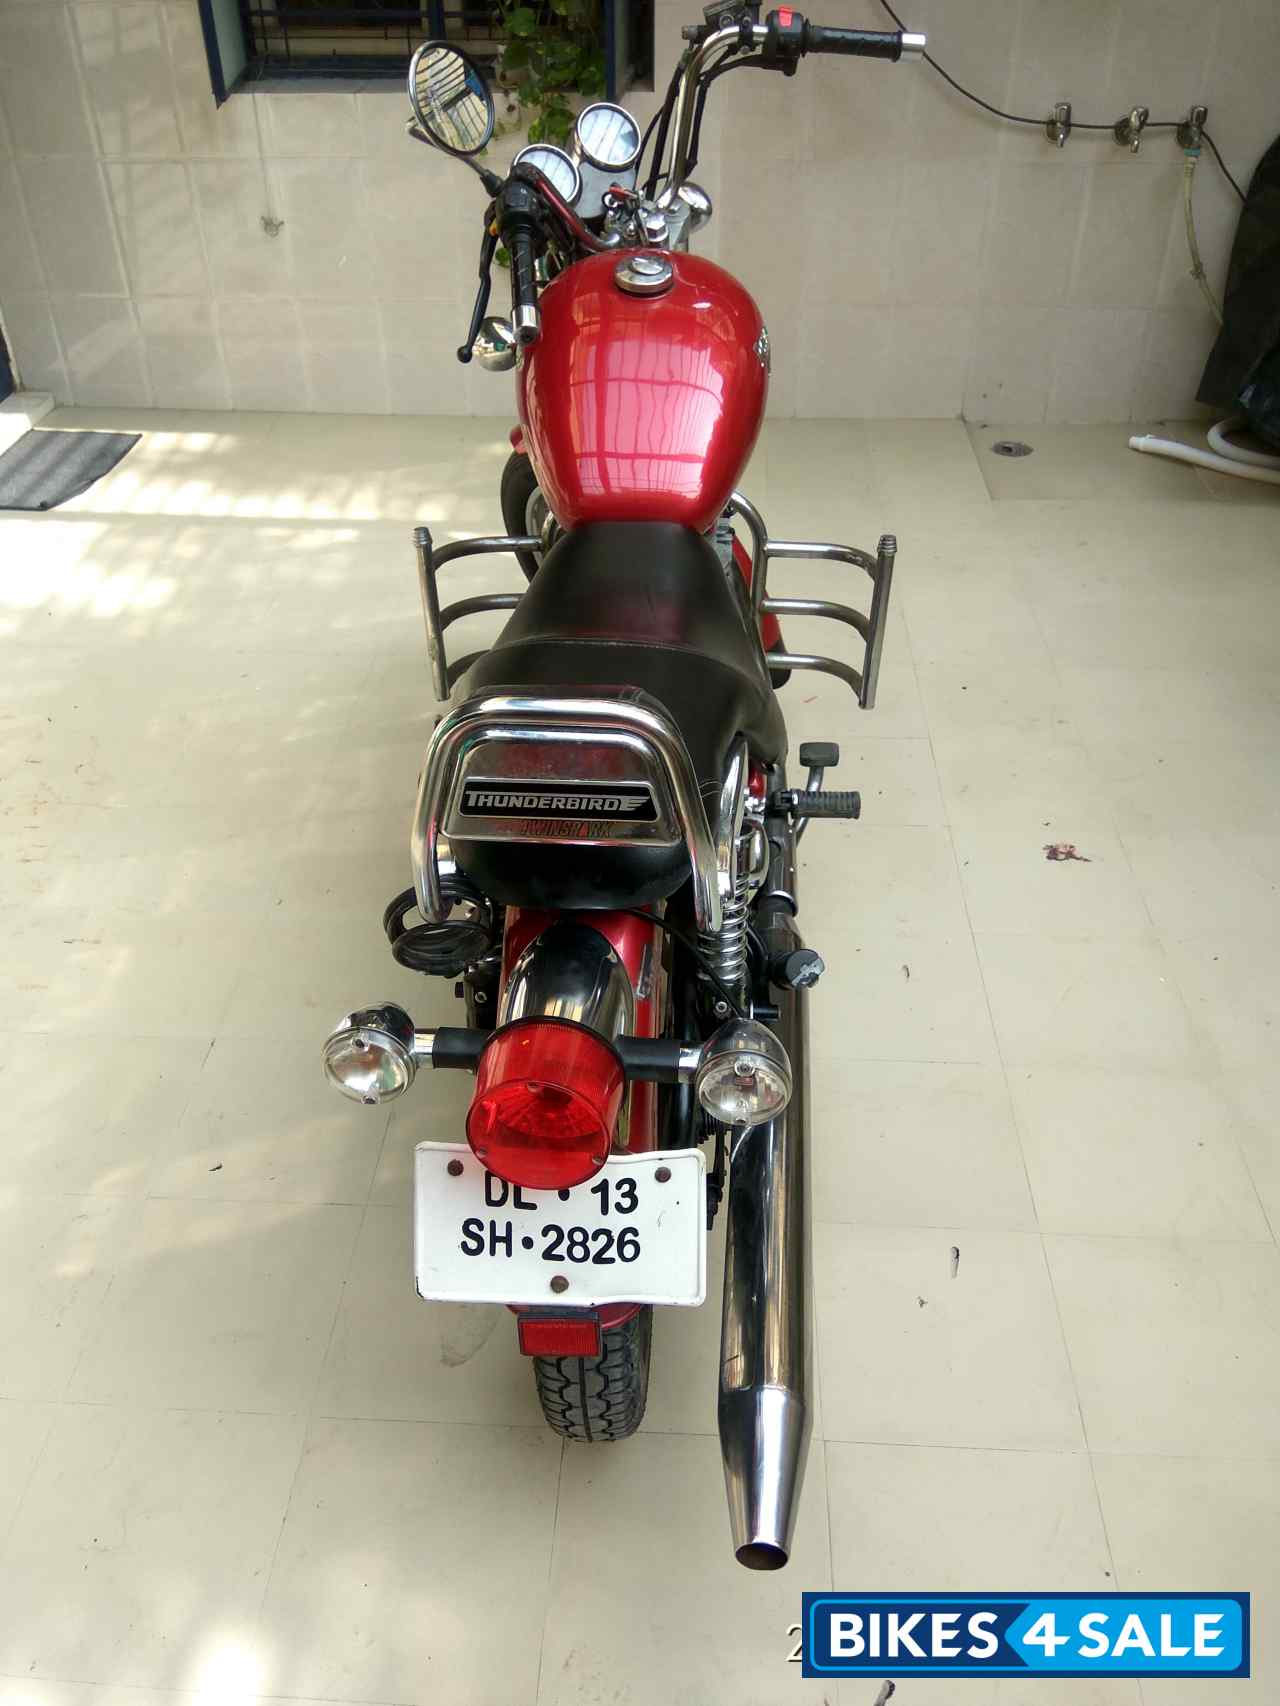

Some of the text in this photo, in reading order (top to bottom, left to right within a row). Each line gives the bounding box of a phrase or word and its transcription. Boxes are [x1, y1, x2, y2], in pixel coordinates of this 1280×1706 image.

[465, 790, 651, 812] THUNDERBIRD
[484, 1169, 639, 1216] DL 13
[460, 1217, 641, 1265] SH 2826
